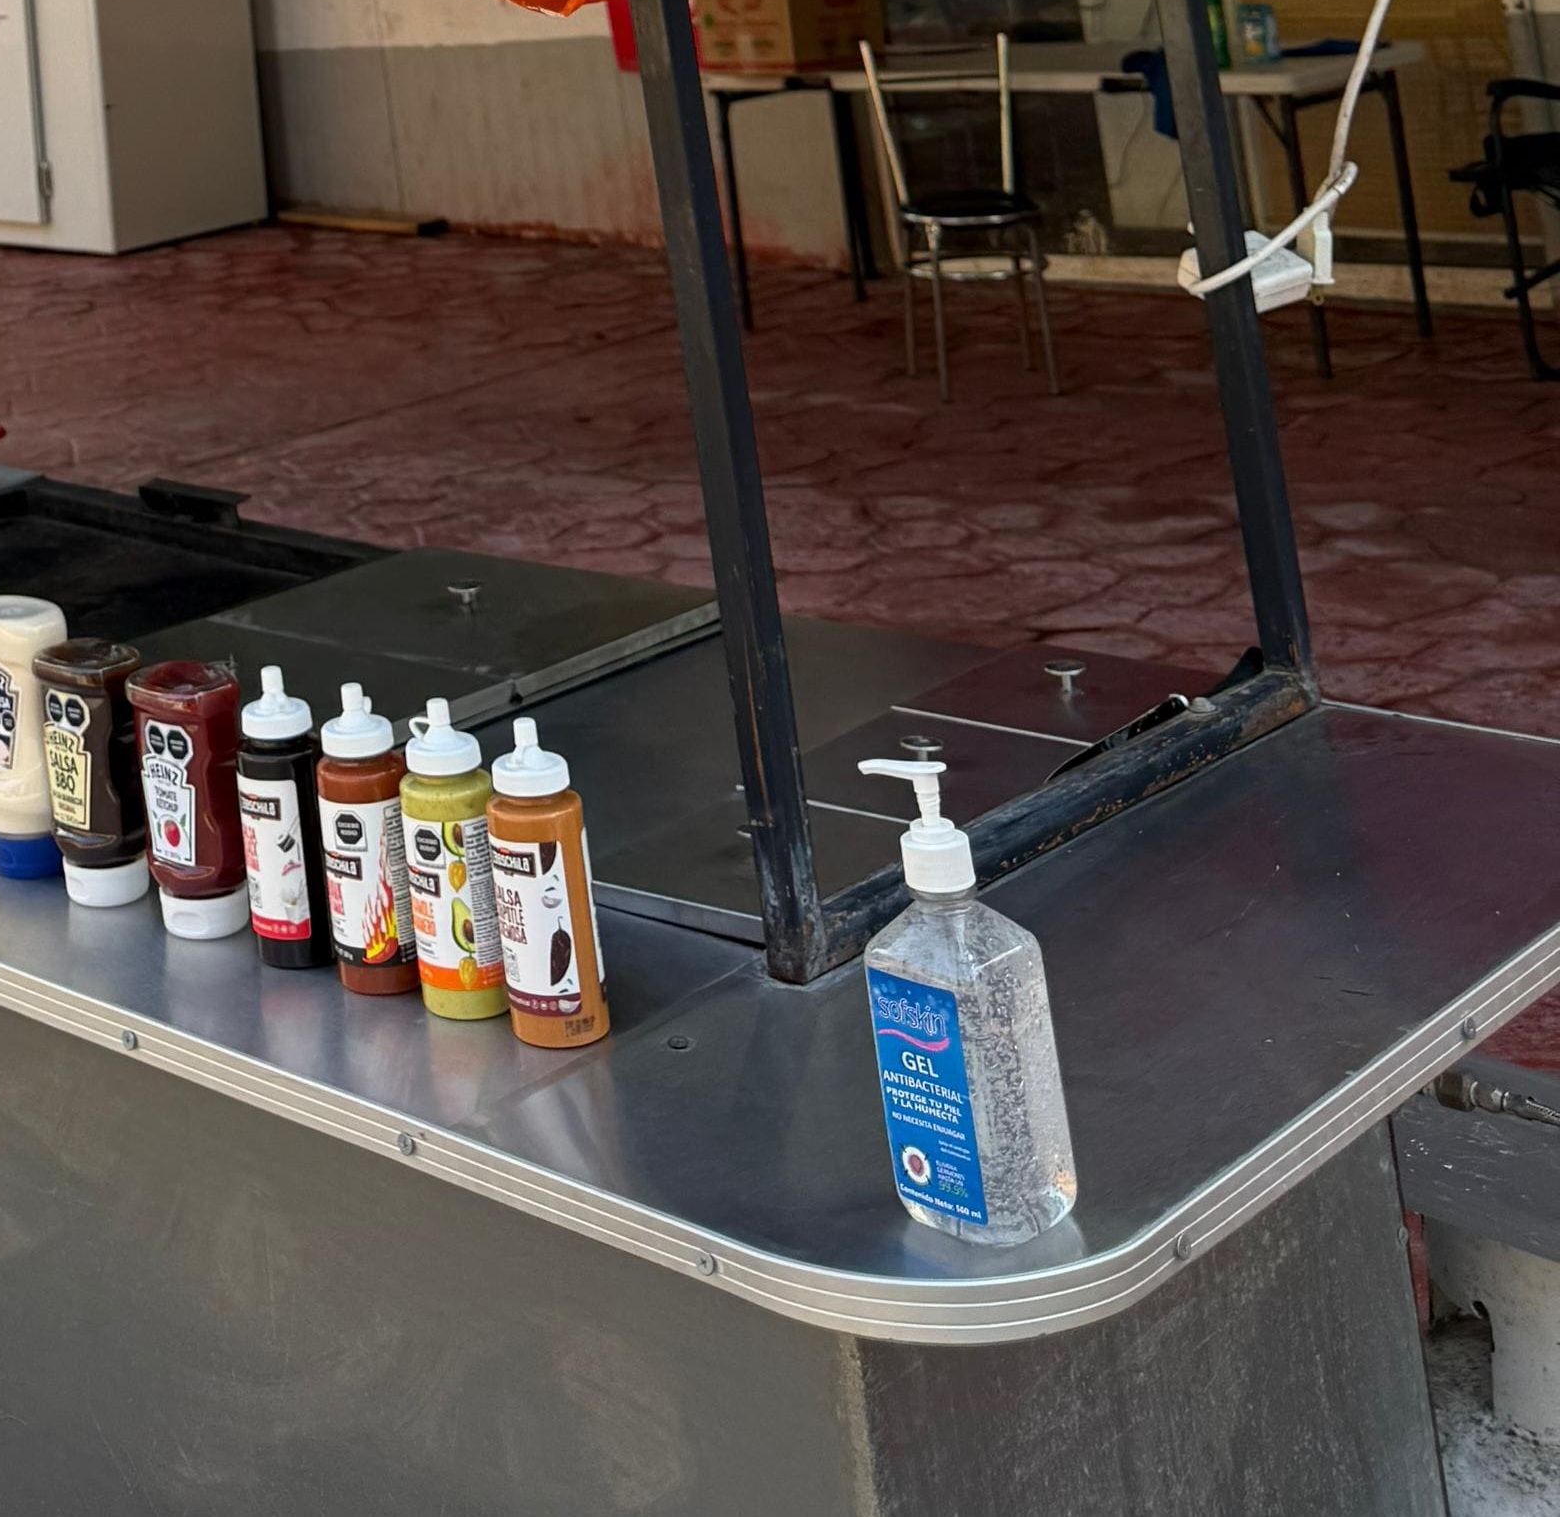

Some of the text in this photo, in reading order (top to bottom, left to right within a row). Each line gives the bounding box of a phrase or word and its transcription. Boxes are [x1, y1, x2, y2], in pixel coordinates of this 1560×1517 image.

[49, 750, 79, 776] SALSA
[149, 762, 179, 786] HEINZ
[901, 1051, 939, 1078] GEL
[883, 1070, 964, 1104] ANTIBACTERIAL
[886, 1086, 963, 1117] PROTEGE TU PIEL
[900, 1099, 913, 1109] LA
[914, 1103, 959, 1124] HUMECTA
